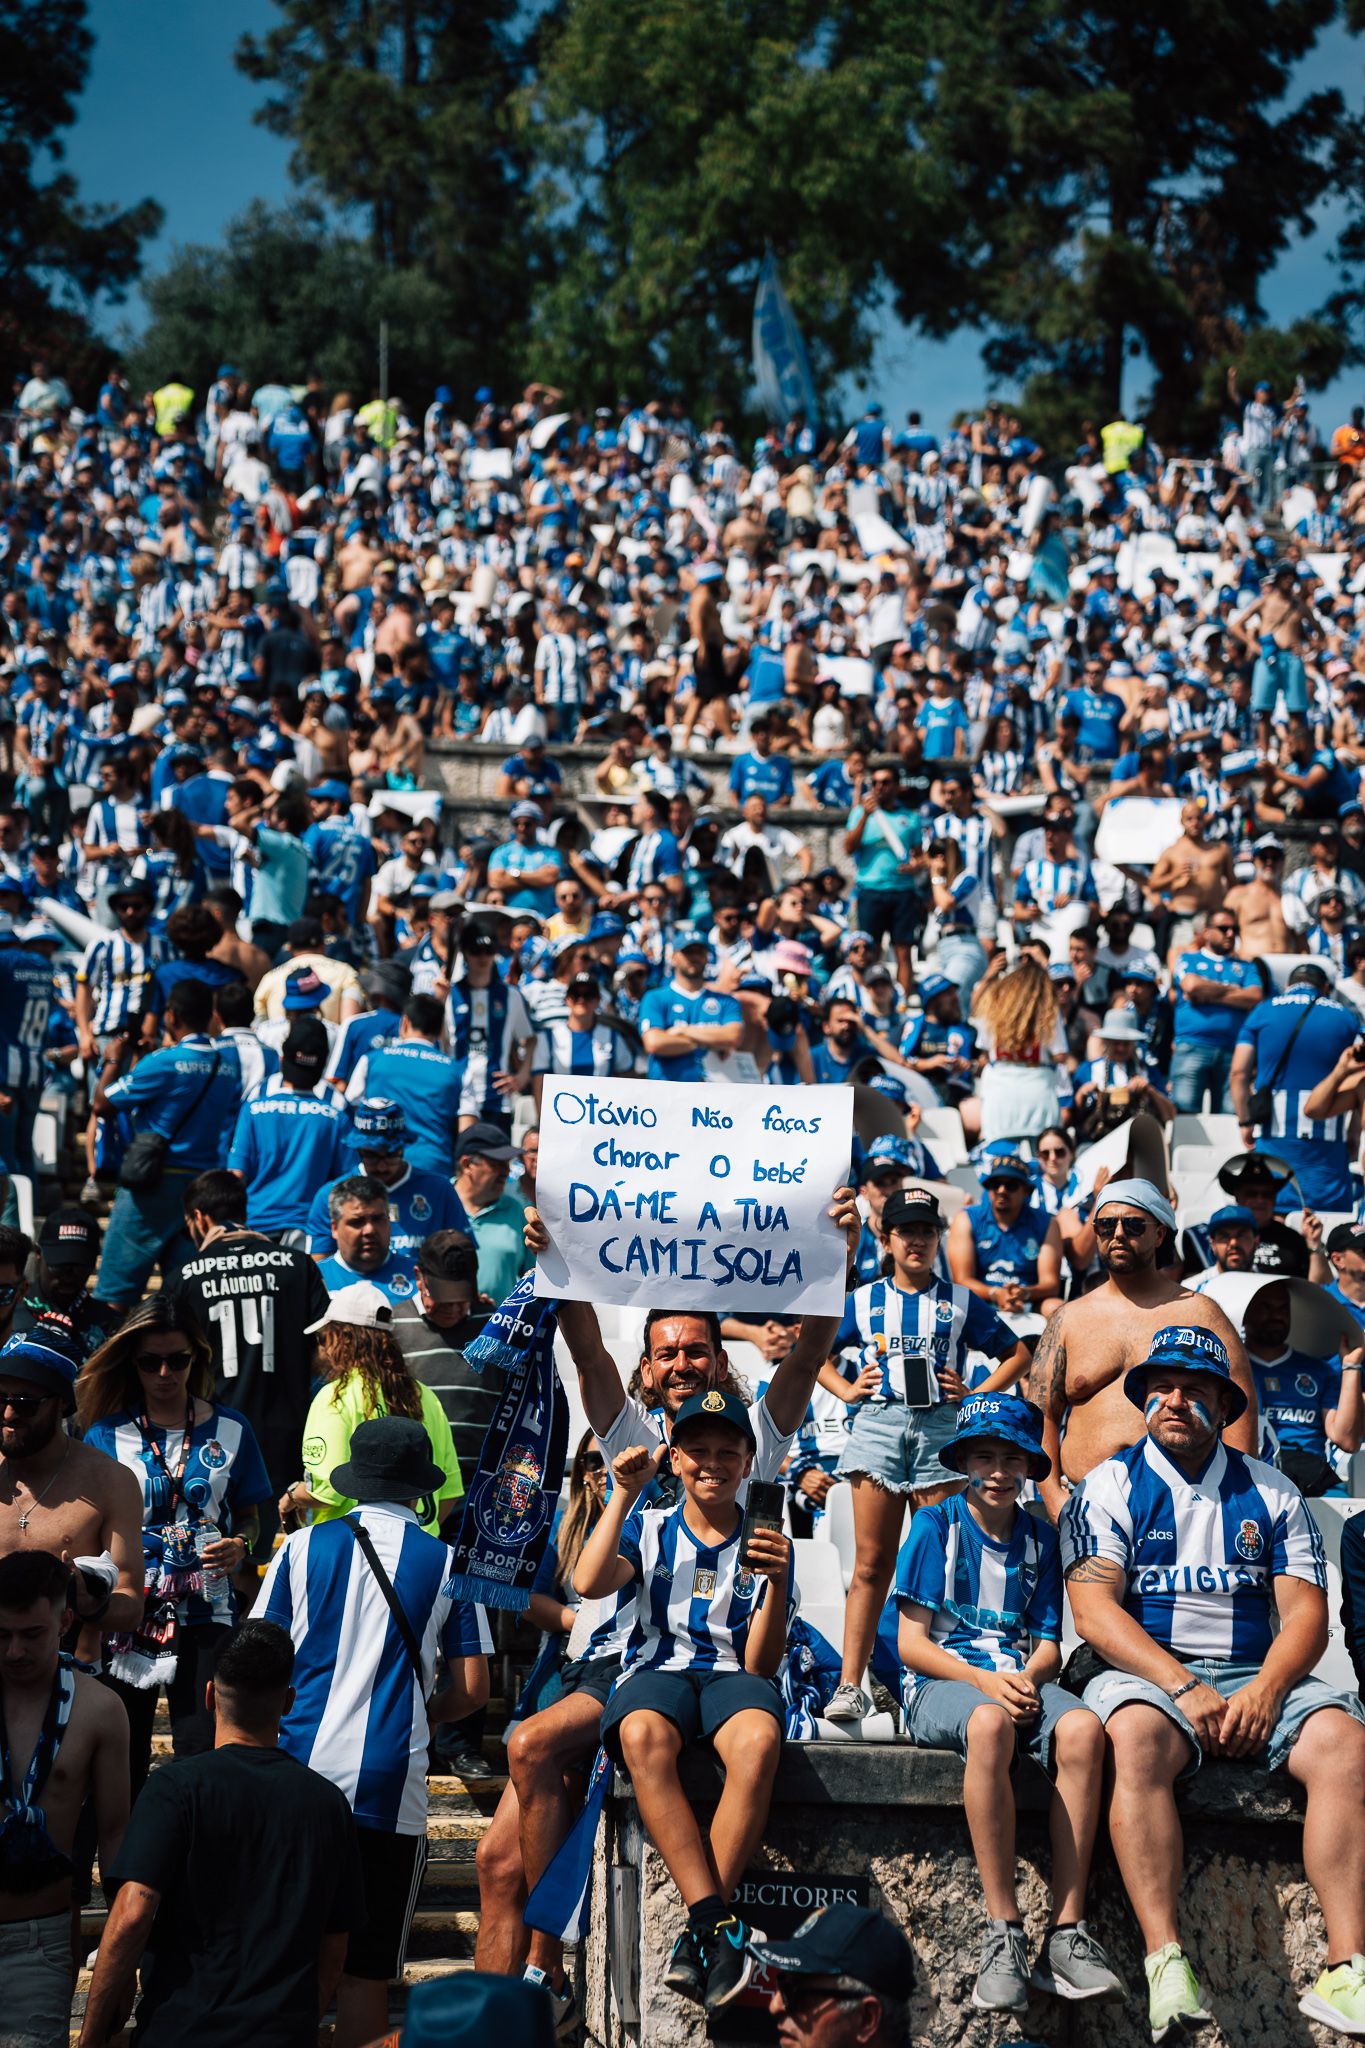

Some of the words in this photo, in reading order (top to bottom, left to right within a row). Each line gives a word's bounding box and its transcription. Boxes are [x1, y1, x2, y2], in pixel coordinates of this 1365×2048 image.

[18, 999, 49, 1048] 18
[250, 1100, 296, 1115] SUPER
[298, 1100, 339, 1120] BOCK
[553, 1092, 657, 1128] Otávio
[691, 1107, 733, 1129] Não
[761, 1104, 822, 1134] faças
[752, 1158, 808, 1184] bebé
[568, 1180, 678, 1224] DÁ-ME
[697, 1201, 722, 1232] A
[734, 1198, 790, 1232] TUA
[181, 1255, 239, 1280] SUPER
[241, 1251, 294, 1269] BOCK
[598, 1234, 804, 1287] CAMISOLA
[201, 1273, 263, 1299] CLÁUDIO
[265, 1272, 280, 1291] R.
[208, 1295, 275, 1378] 14
[490, 1312, 534, 1337] ORTO
[889, 1336, 950, 1354] BETANO
[483, 1550, 537, 1573] PORTO
